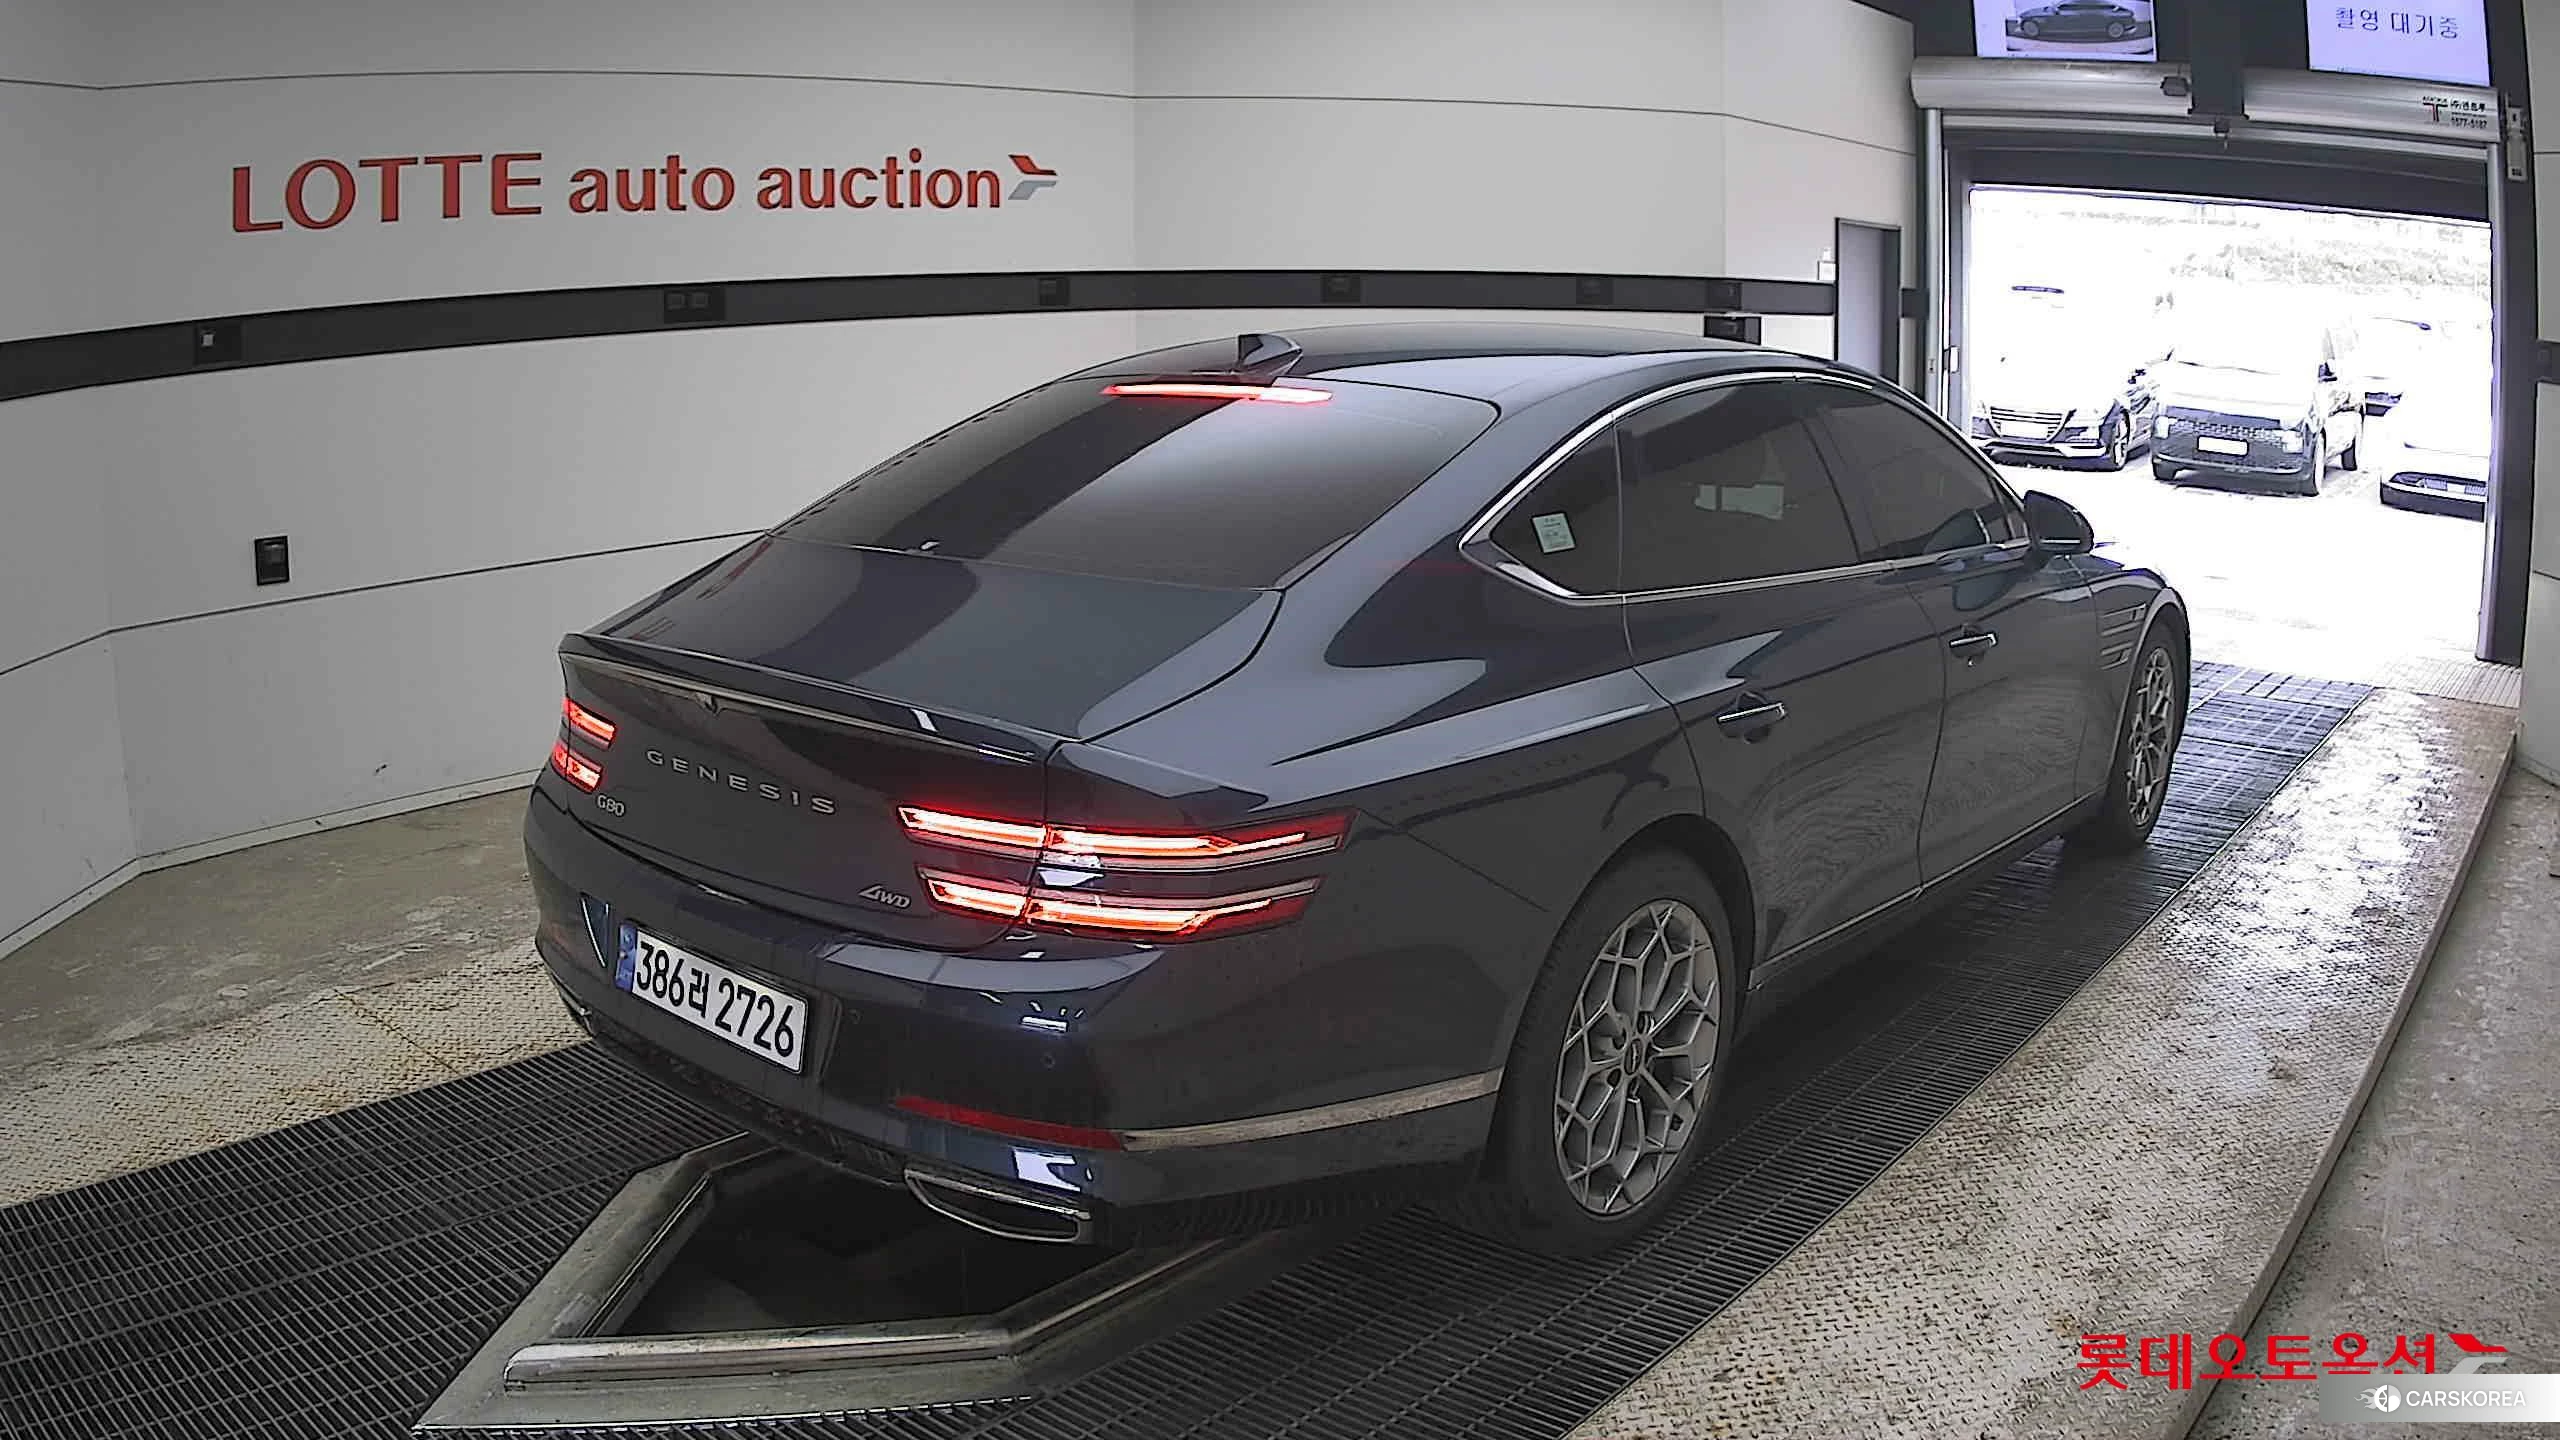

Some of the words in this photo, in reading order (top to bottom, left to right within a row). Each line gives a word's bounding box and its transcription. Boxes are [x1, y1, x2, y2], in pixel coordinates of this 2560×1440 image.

[2391, 12, 2458, 39] 대기중
[232, 152, 542, 233] LOTTE
[569, 154, 735, 213] auto
[757, 147, 1001, 210] auction
[597, 794, 625, 817] G80
[646, 750, 835, 815] GENESIS
[715, 977, 794, 1058] 2726
